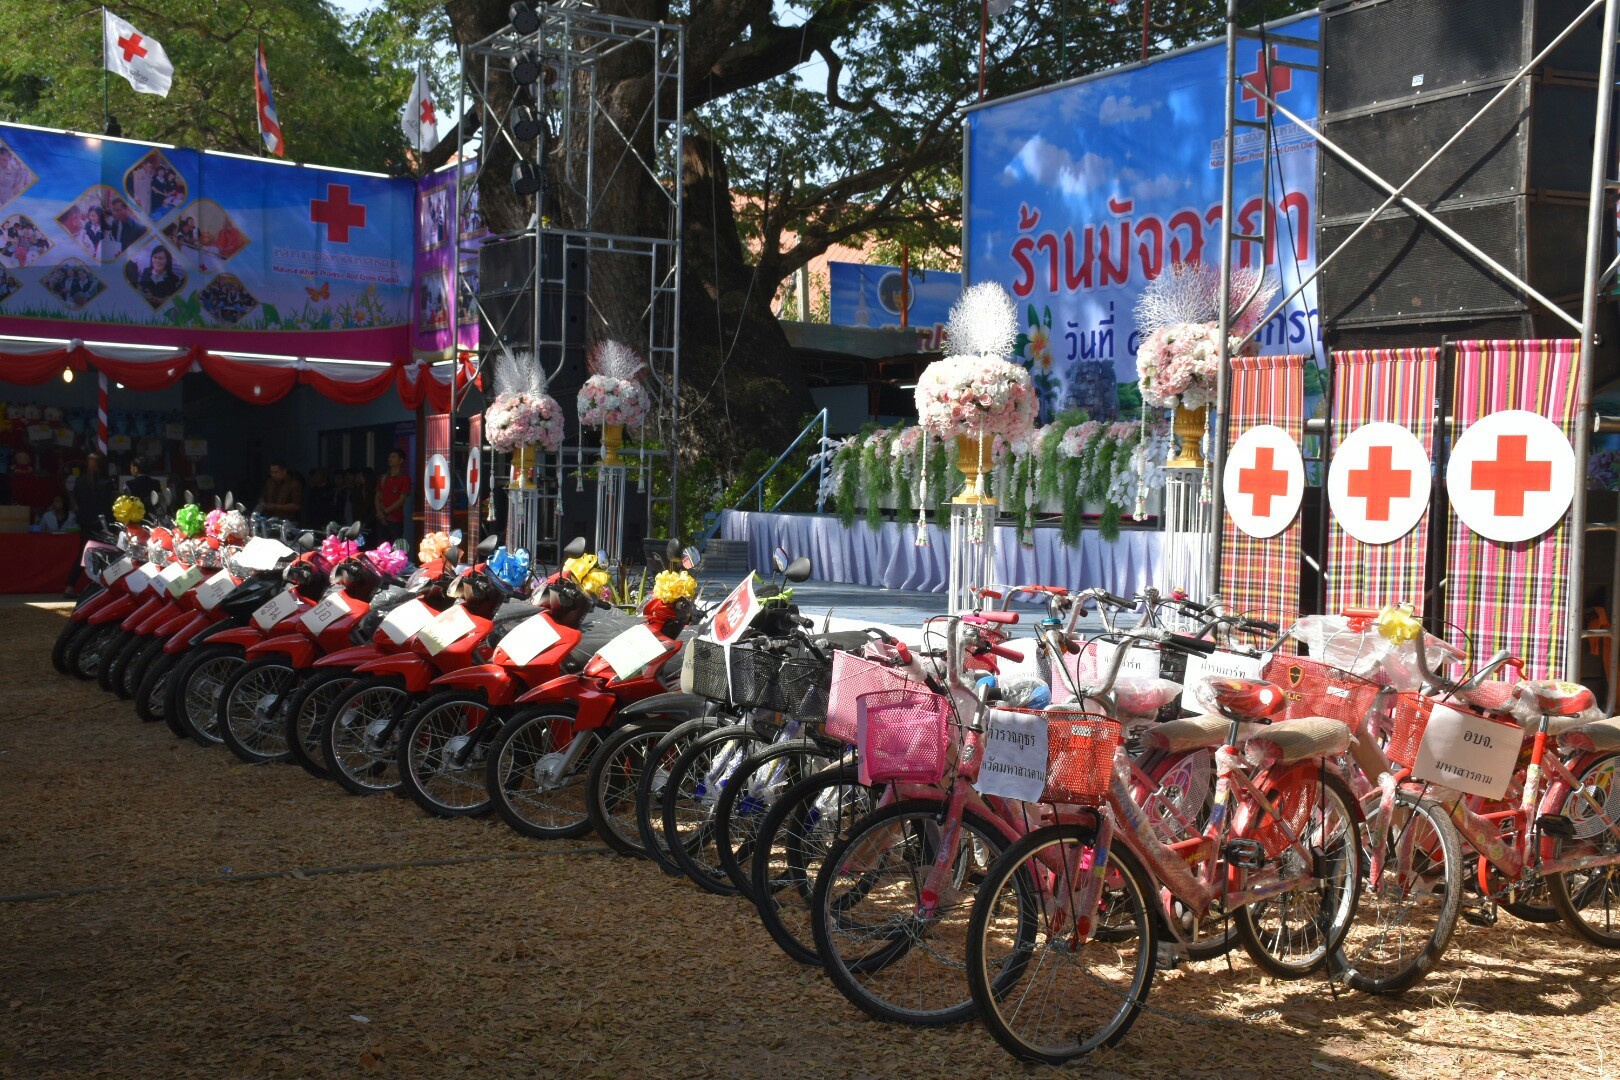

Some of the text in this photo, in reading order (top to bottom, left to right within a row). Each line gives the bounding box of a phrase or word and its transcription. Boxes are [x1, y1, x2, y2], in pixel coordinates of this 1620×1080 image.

[346, 271, 359, 280] Red
[360, 273, 376, 281] Cross
[1064, 301, 1115, 361] วันที่
[1463, 730, 1493, 749] อบจ.
[1435, 760, 1493, 785] มหาสารคาม
